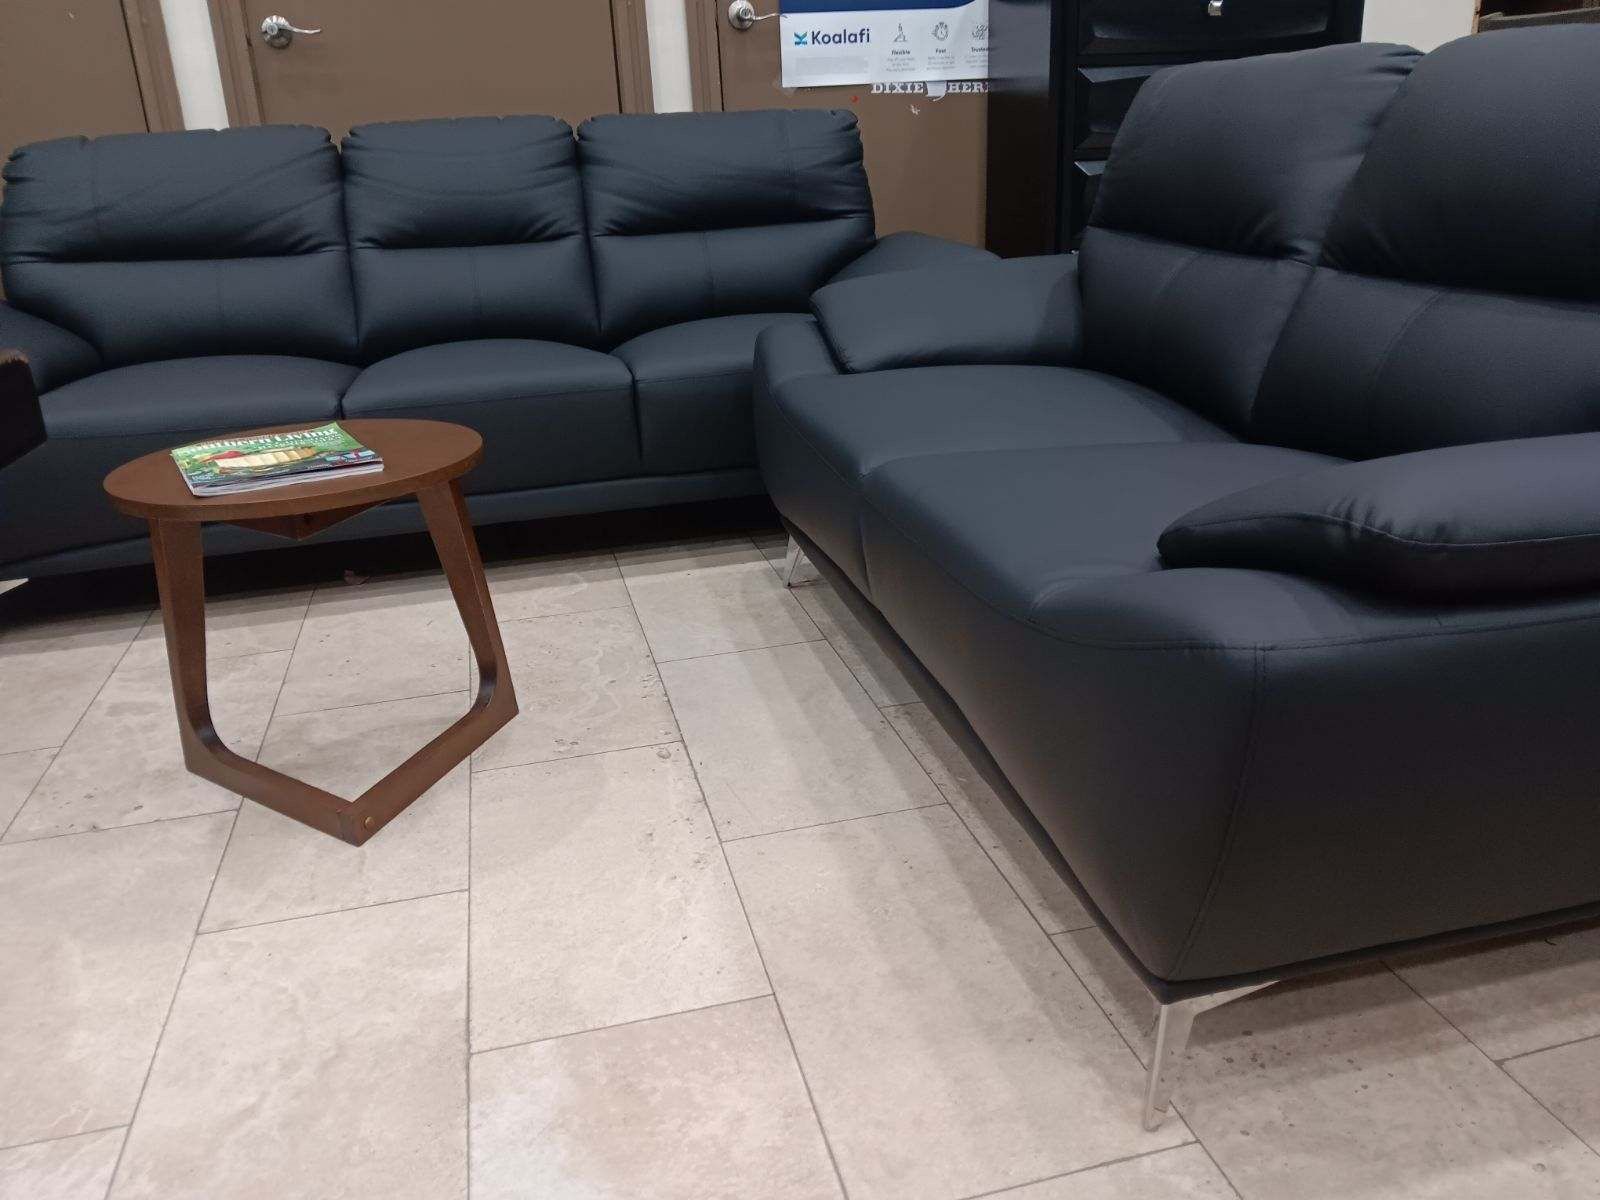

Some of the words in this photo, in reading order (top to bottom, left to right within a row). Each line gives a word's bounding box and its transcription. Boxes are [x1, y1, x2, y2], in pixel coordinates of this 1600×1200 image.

[811, 28, 870, 45] Koalafi
[871, 82, 924, 94] DIXIE
[947, 82, 989, 93] HER
